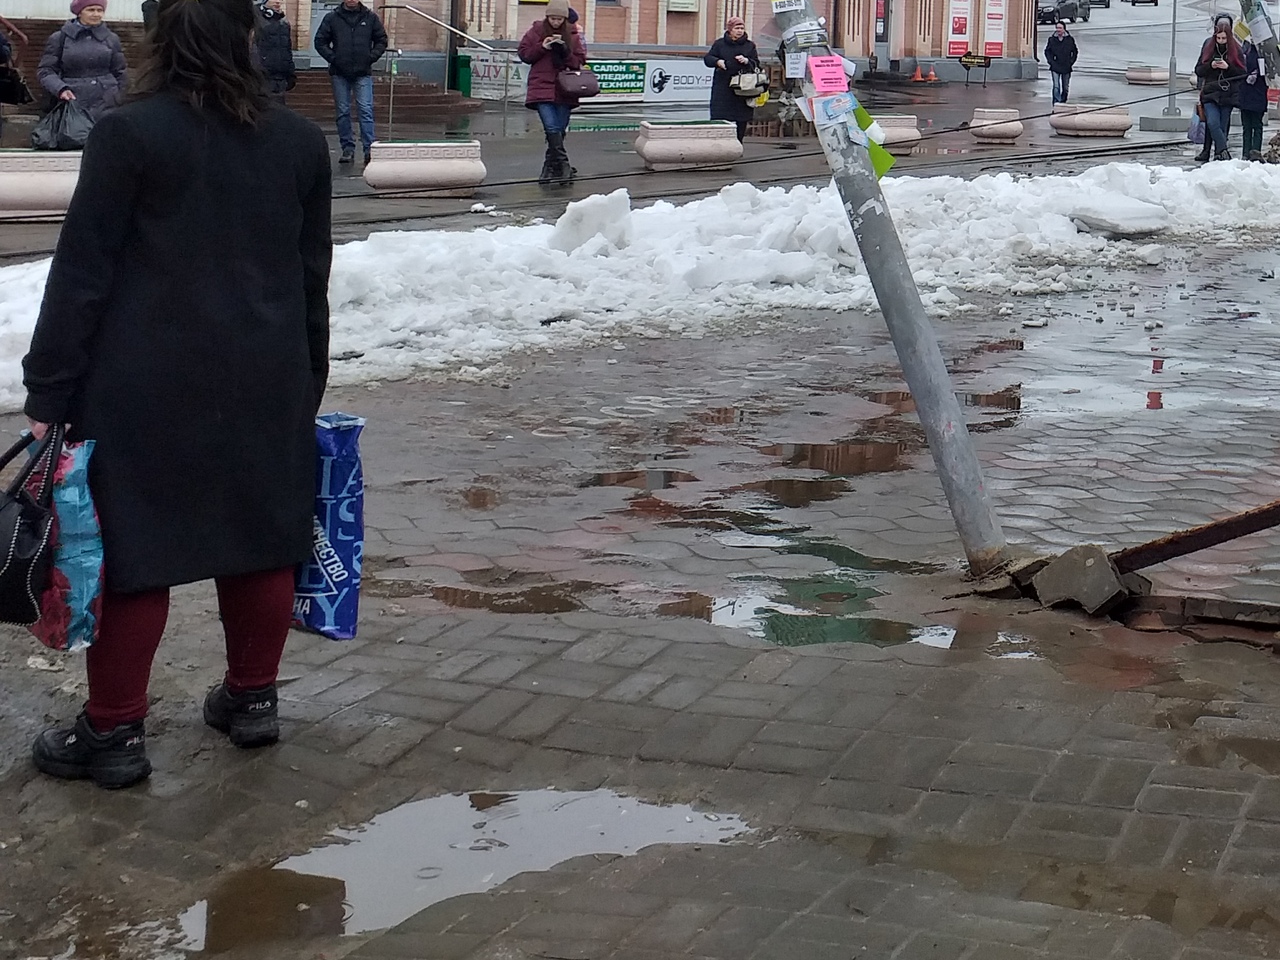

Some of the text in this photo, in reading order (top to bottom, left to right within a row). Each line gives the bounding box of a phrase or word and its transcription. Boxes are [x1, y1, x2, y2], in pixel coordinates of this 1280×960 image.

[592, 64, 626, 72] САЛОН
[312, 514, 350, 582] АЧЕСТВО
[248, 701, 272, 711] FILA
[125, 736, 146, 747] FIL
